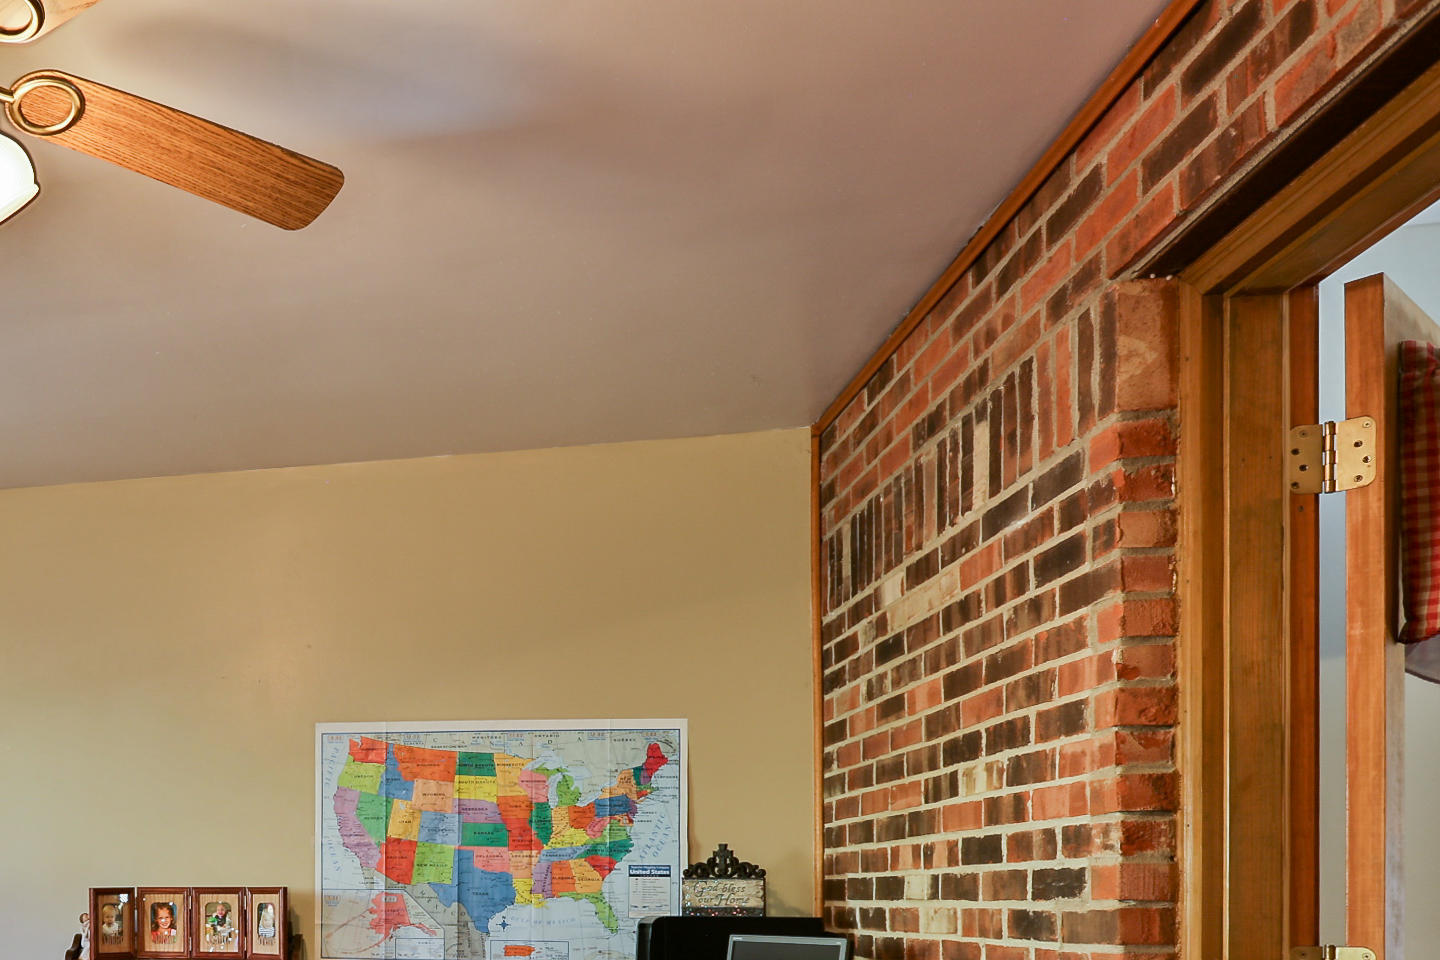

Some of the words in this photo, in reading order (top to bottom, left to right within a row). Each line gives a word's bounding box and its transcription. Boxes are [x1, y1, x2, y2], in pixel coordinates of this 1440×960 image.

[693, 881, 720, 897] God
[721, 884, 746, 893] bless
[714, 893, 750, 906] Home
